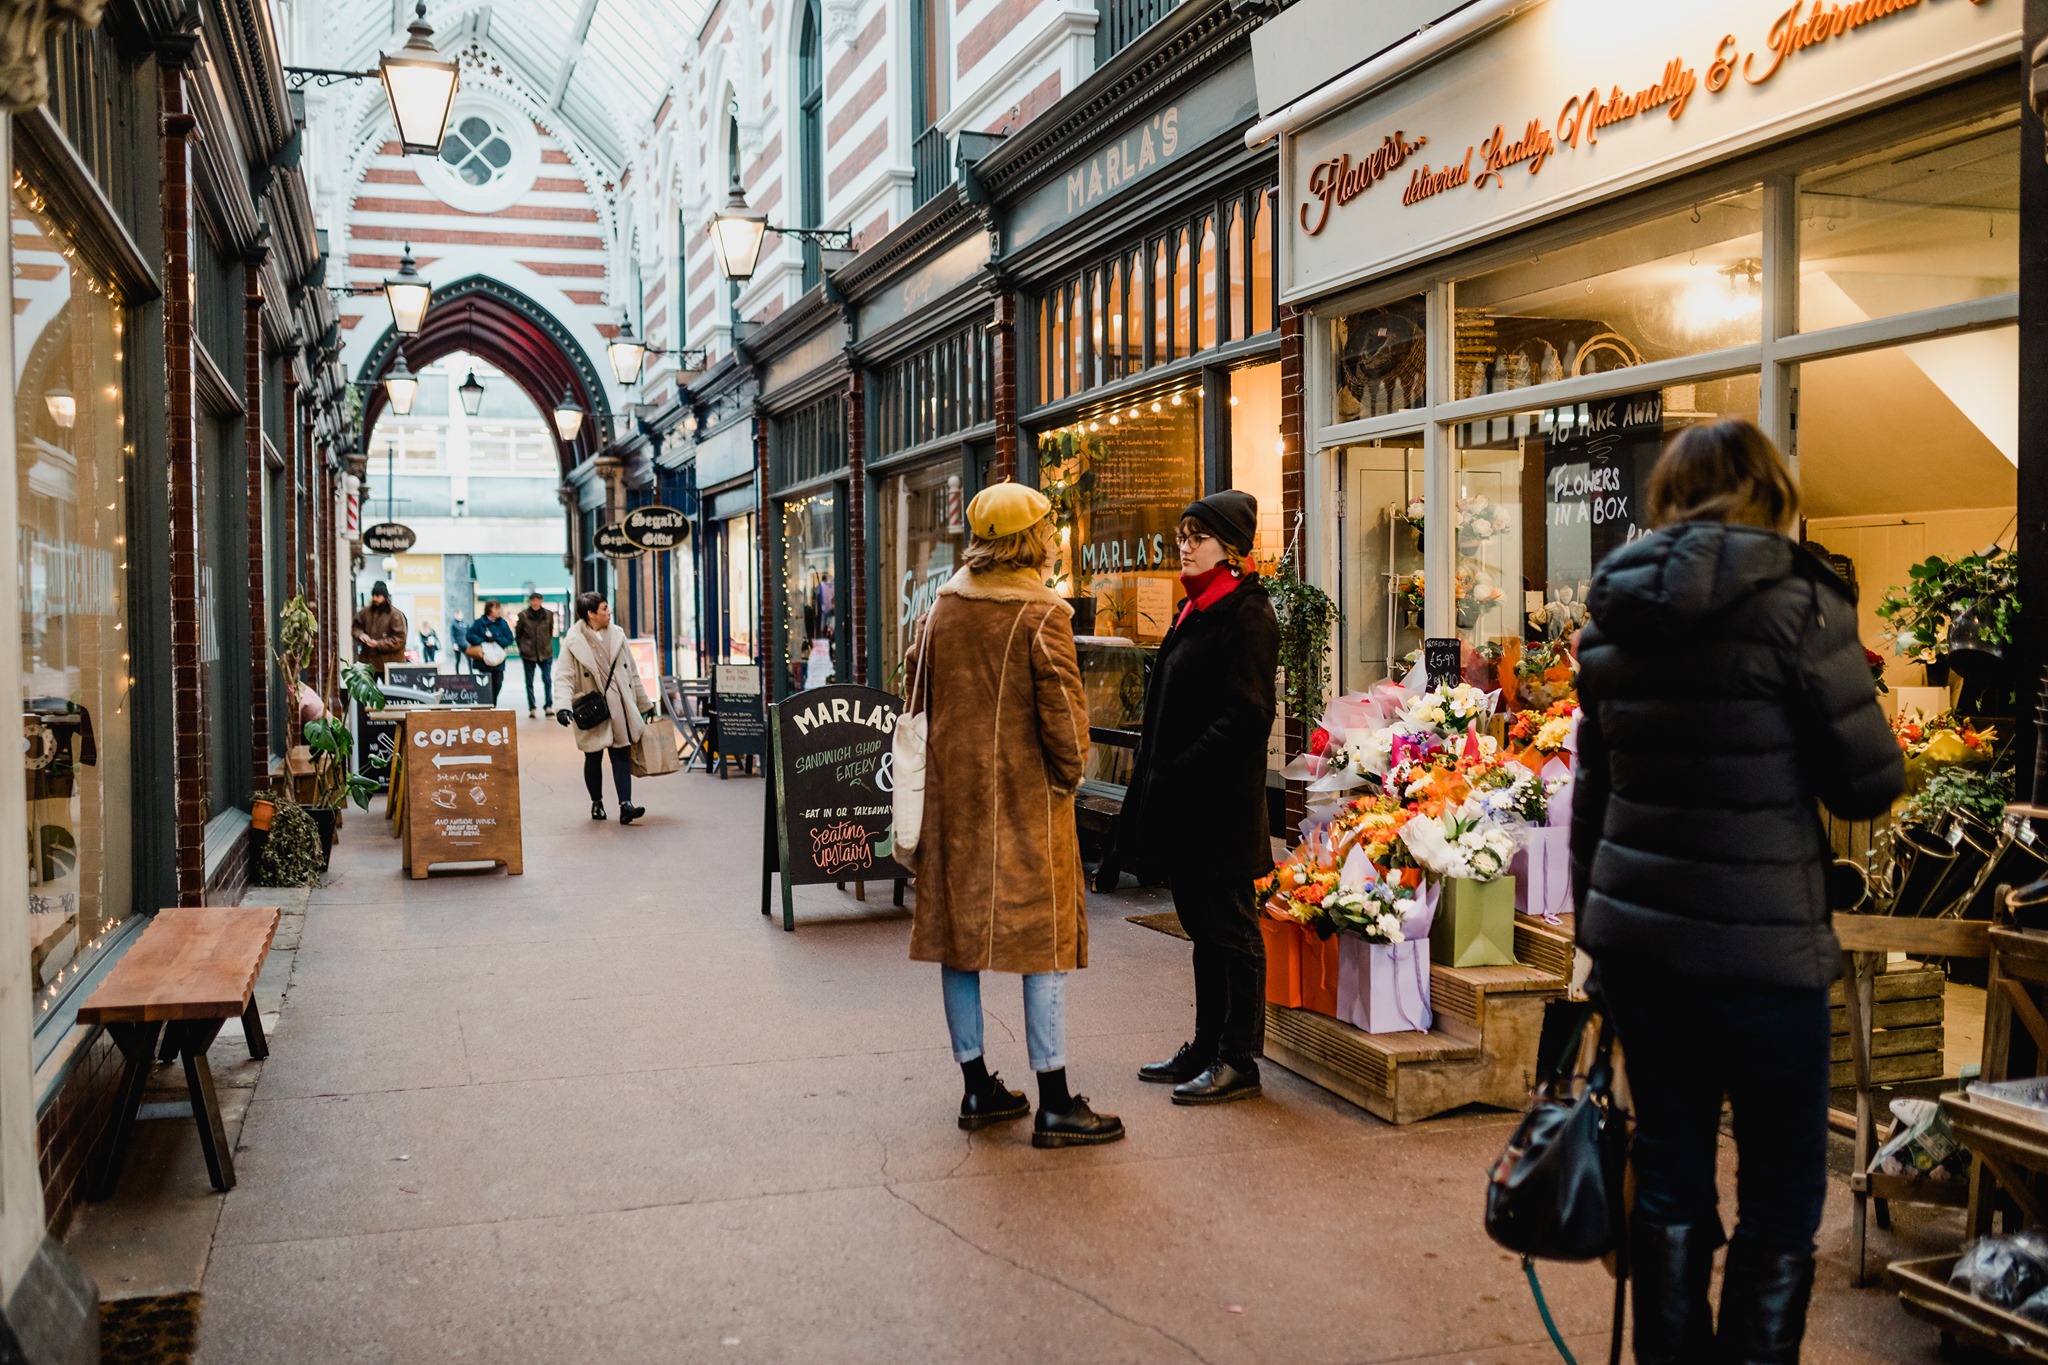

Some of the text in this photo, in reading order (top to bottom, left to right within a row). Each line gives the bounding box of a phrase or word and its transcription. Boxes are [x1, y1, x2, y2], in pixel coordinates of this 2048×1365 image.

[1402, 146, 1473, 206] delivered
[1556, 56, 1697, 149] Nationally
[1704, 34, 1739, 93] &
[1067, 106, 1179, 214] MARLA'S
[1623, 399, 1661, 428] AWAY
[1554, 462, 1620, 503] FLOWERS
[631, 512, 683, 530] Segal's
[1555, 496, 1628, 526] IN A BOX
[1081, 533, 1163, 576] MARLA'S
[793, 699, 897, 736] MARLA'S
[795, 740, 881, 774] SANDWICH SHOP
[836, 757, 877, 782] EATERY
[805, 808, 820, 819] EAT
[823, 808, 832, 818] IN
[836, 807, 847, 817] OR
[810, 821, 879, 852] Seating
